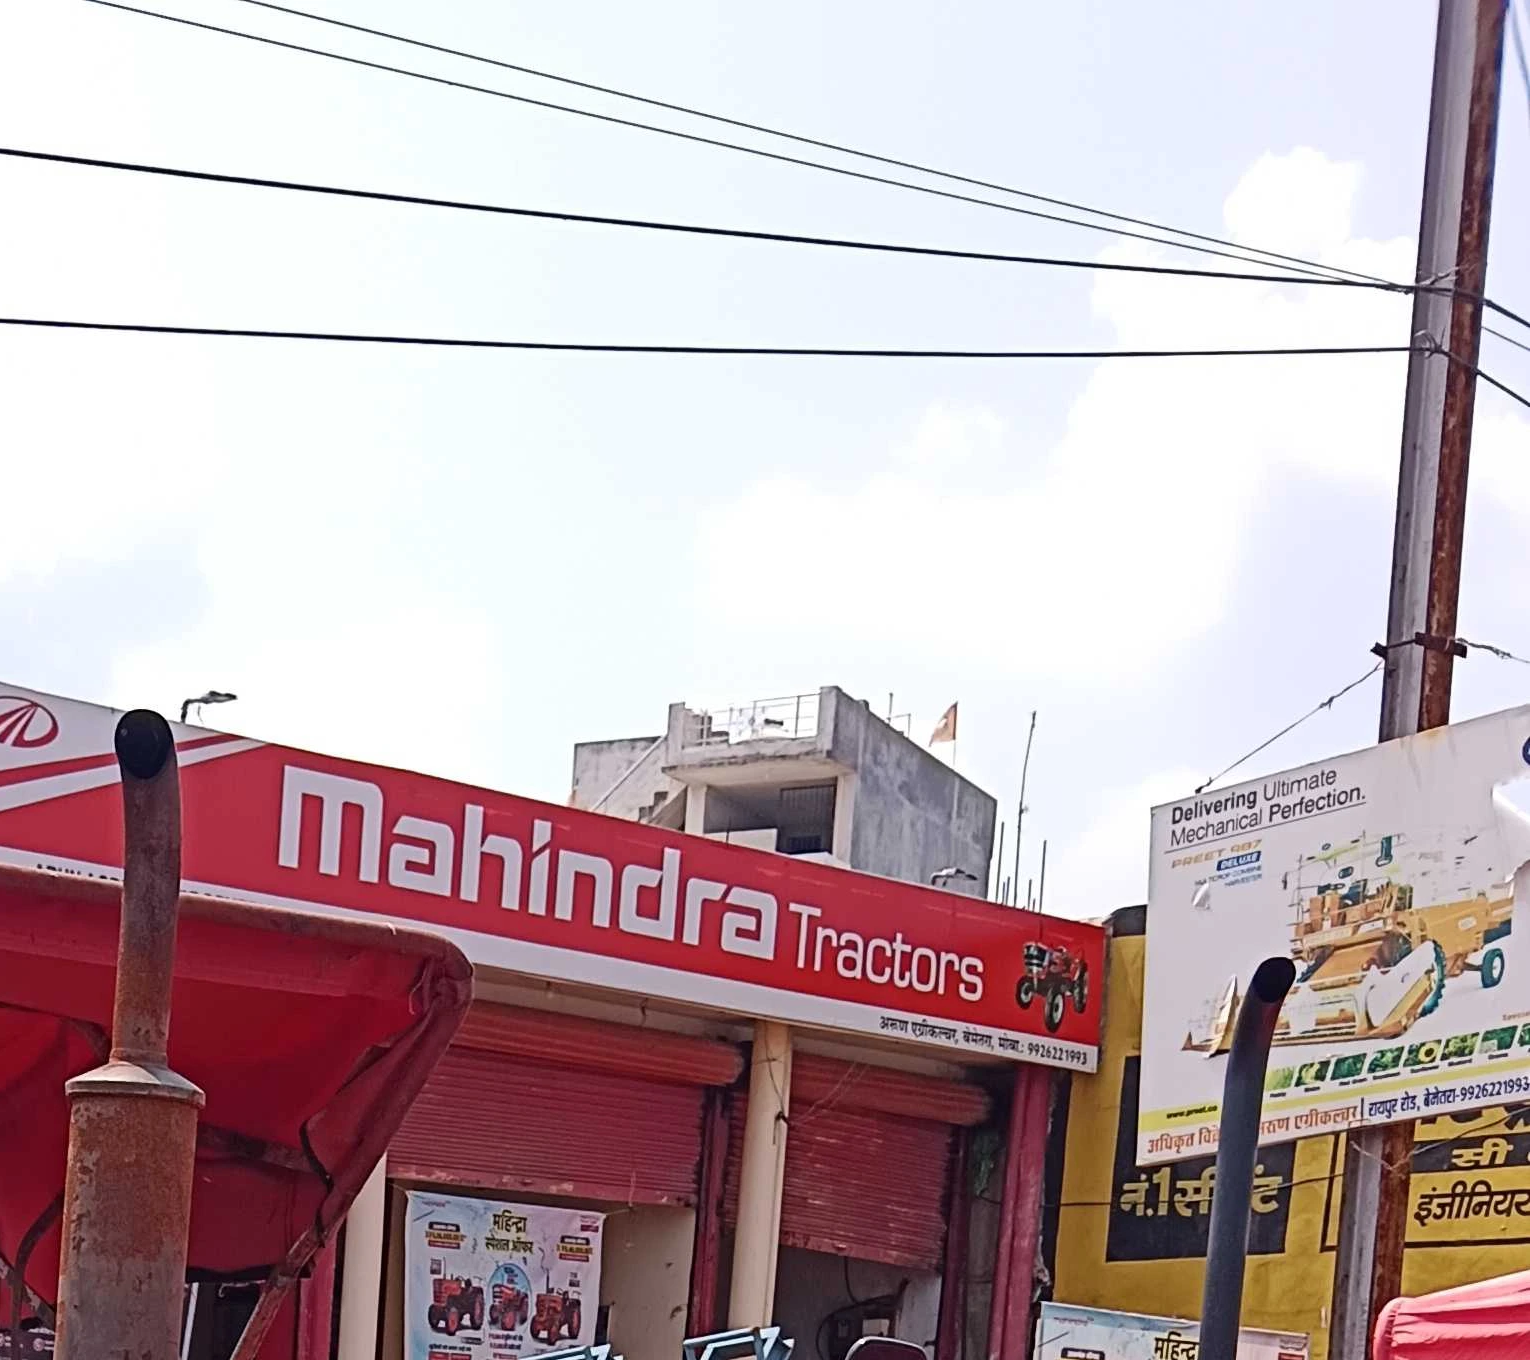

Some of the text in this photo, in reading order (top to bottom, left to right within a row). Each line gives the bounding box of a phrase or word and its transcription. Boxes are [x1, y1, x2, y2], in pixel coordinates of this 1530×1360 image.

[1170, 786, 1367, 847] Mechanical Perfection.
[1171, 768, 1338, 825] Delivering Ultimate
[1171, 847, 1227, 869] PREET
[1219, 852, 1261, 871] DELUXE
[789, 902, 985, 1002] Tractors
[1027, 1042, 1088, 1066] 9926221993
